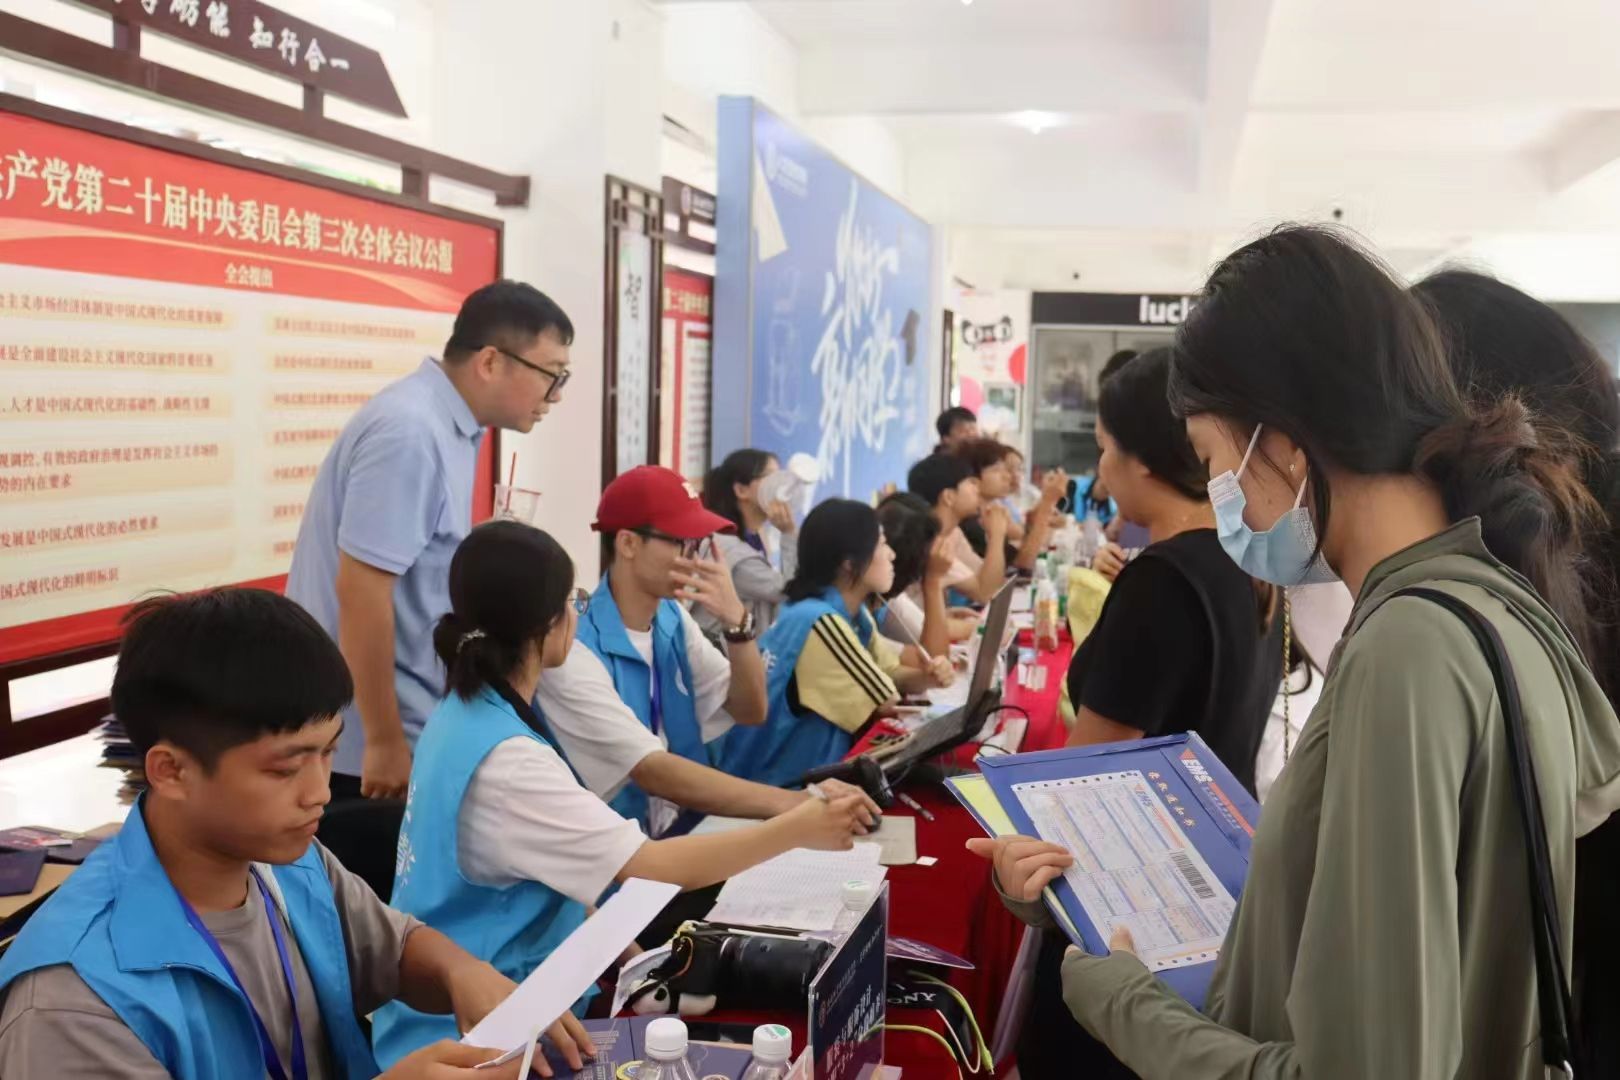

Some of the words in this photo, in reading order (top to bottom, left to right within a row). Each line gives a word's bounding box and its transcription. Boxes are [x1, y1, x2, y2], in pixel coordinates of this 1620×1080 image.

[249, 16, 349, 72] 知行合一
[0, 149, 453, 275] 产党第二十届中央委员会第三次全体会议公报
[887, 991, 937, 1004] ONY
